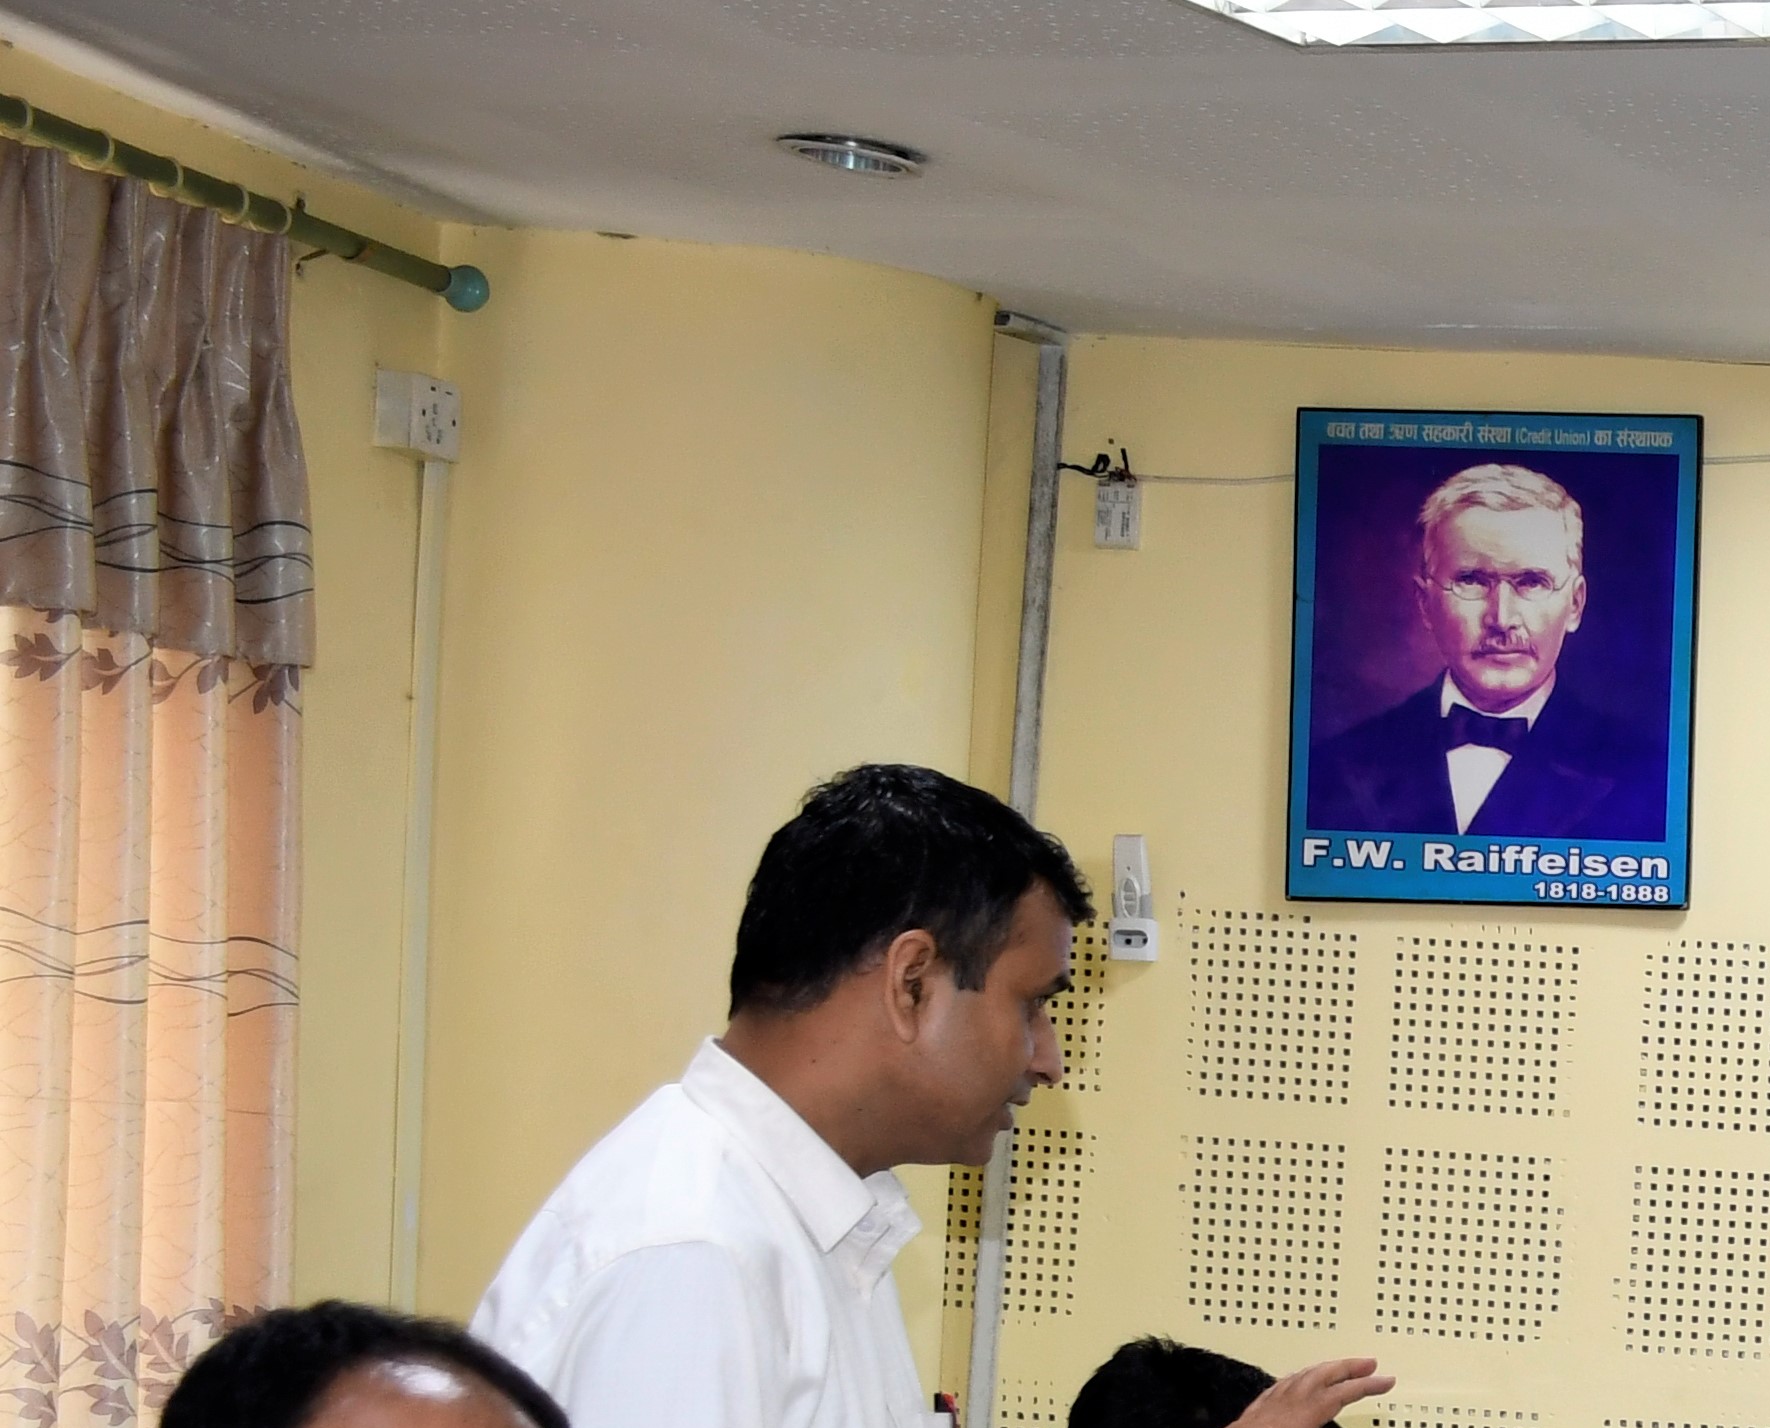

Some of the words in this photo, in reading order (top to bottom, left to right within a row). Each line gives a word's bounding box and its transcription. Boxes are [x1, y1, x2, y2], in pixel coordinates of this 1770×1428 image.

[1360, 423, 1384, 439] तथा
[1423, 422, 1473, 443] सहकारी
[1477, 424, 1511, 443] संस्था
[1555, 429, 1590, 445] Union)
[1595, 430, 1612, 445] का
[1616, 428, 1673, 448] संस्थापक
[1302, 838, 1405, 868] F.W.
[1423, 842, 1669, 879] Raiffeisen
[1533, 880, 1669, 902] 1818-1888
